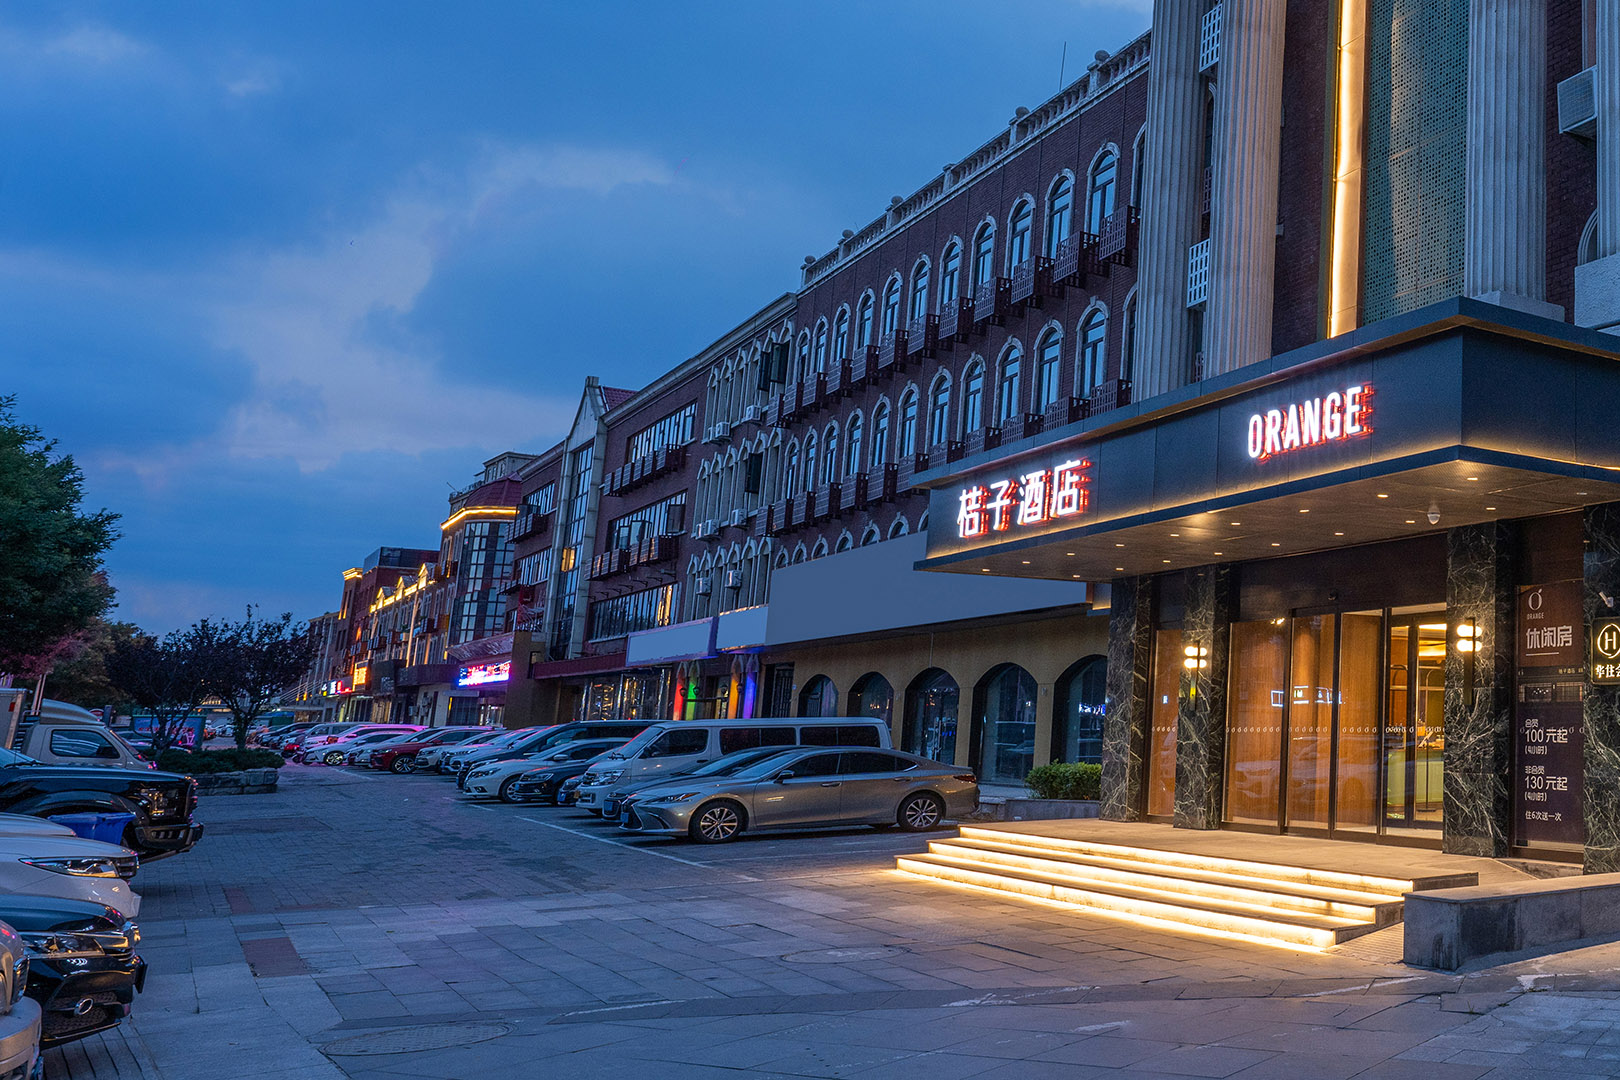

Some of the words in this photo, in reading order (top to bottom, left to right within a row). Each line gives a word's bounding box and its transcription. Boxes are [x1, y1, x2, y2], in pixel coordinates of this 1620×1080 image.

[1247, 385, 1366, 459] ORANGE
[957, 458, 1084, 539] 桔子酒店
[1525, 625, 1573, 649] 休闲房
